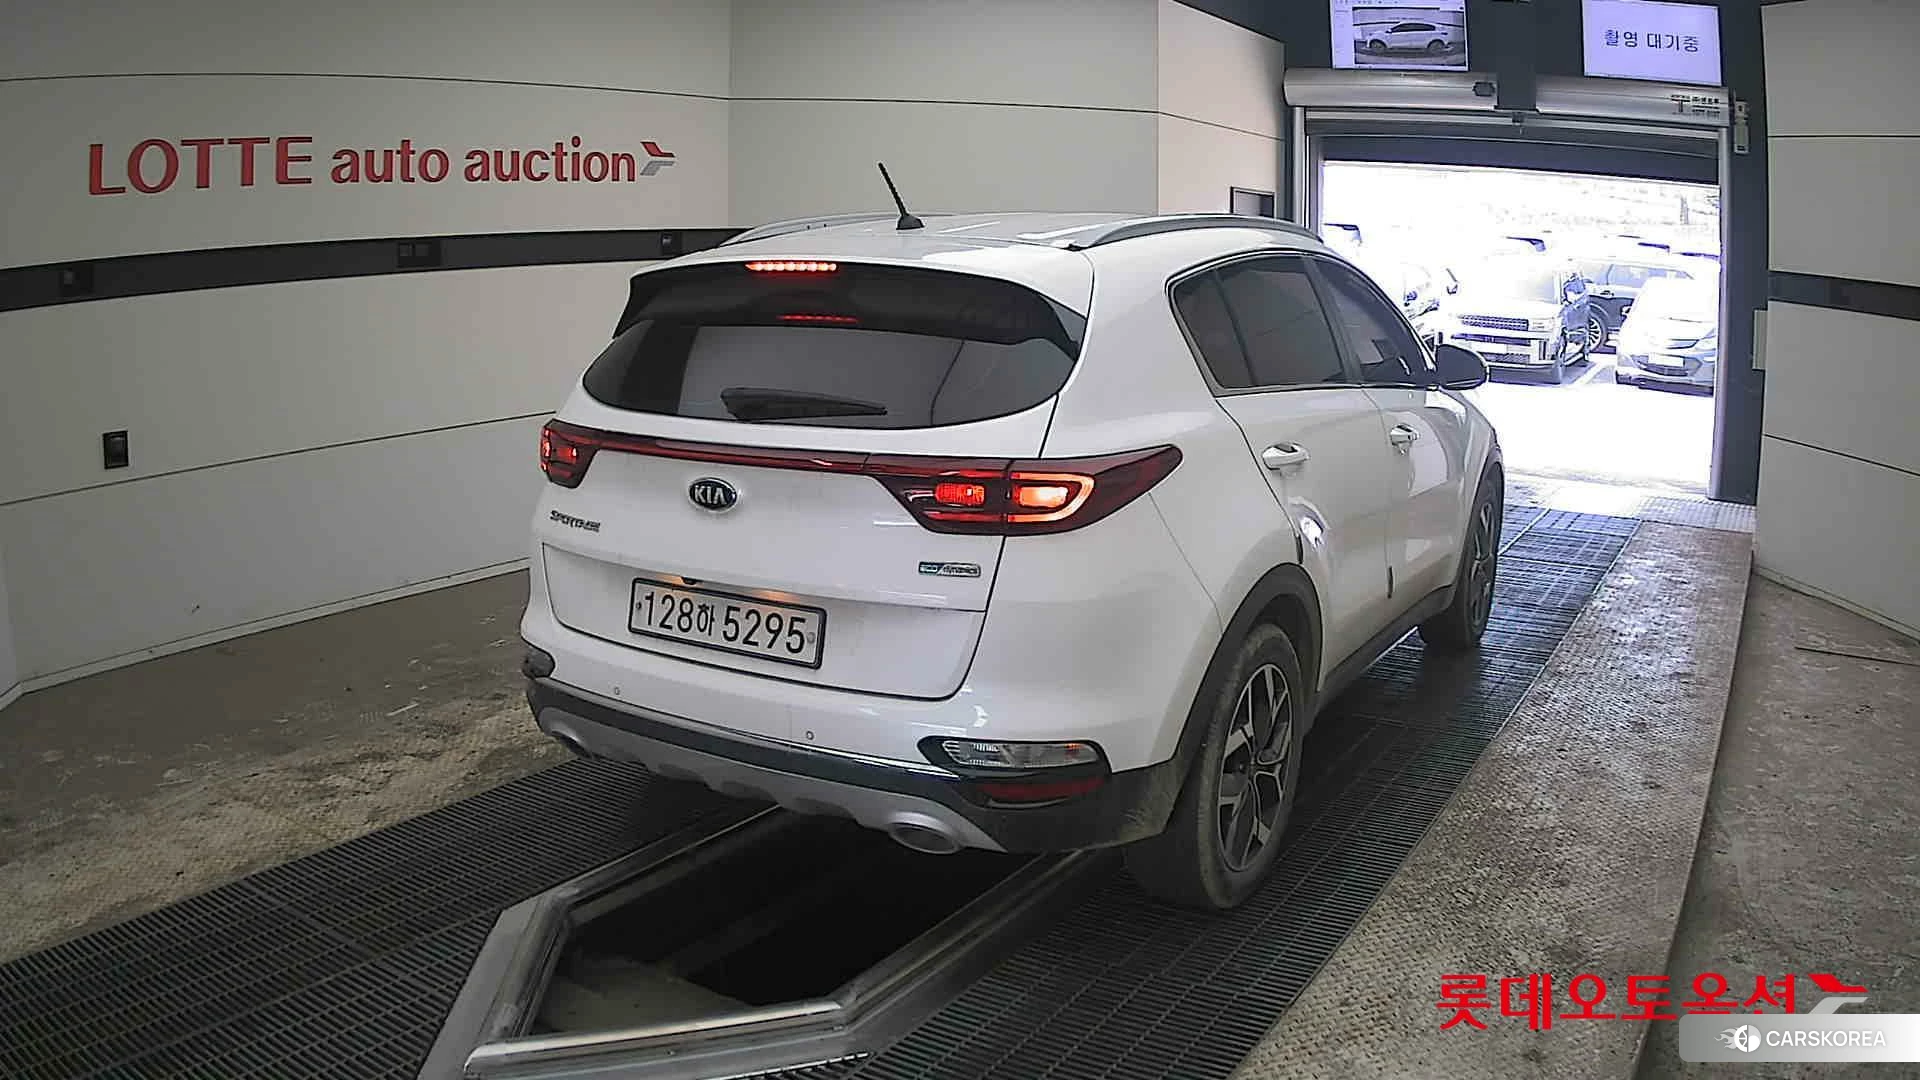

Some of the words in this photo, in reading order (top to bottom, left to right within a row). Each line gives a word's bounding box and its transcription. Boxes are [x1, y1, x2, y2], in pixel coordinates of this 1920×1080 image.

[1646, 33, 1699, 53] 대기중
[89, 136, 313, 195] LOTTE
[331, 139, 449, 184] auto
[464, 136, 636, 183] auction
[694, 485, 728, 505] KIA
[550, 510, 601, 533] SPORT
[645, 591, 716, 636] 128하
[722, 605, 807, 654] 5295
